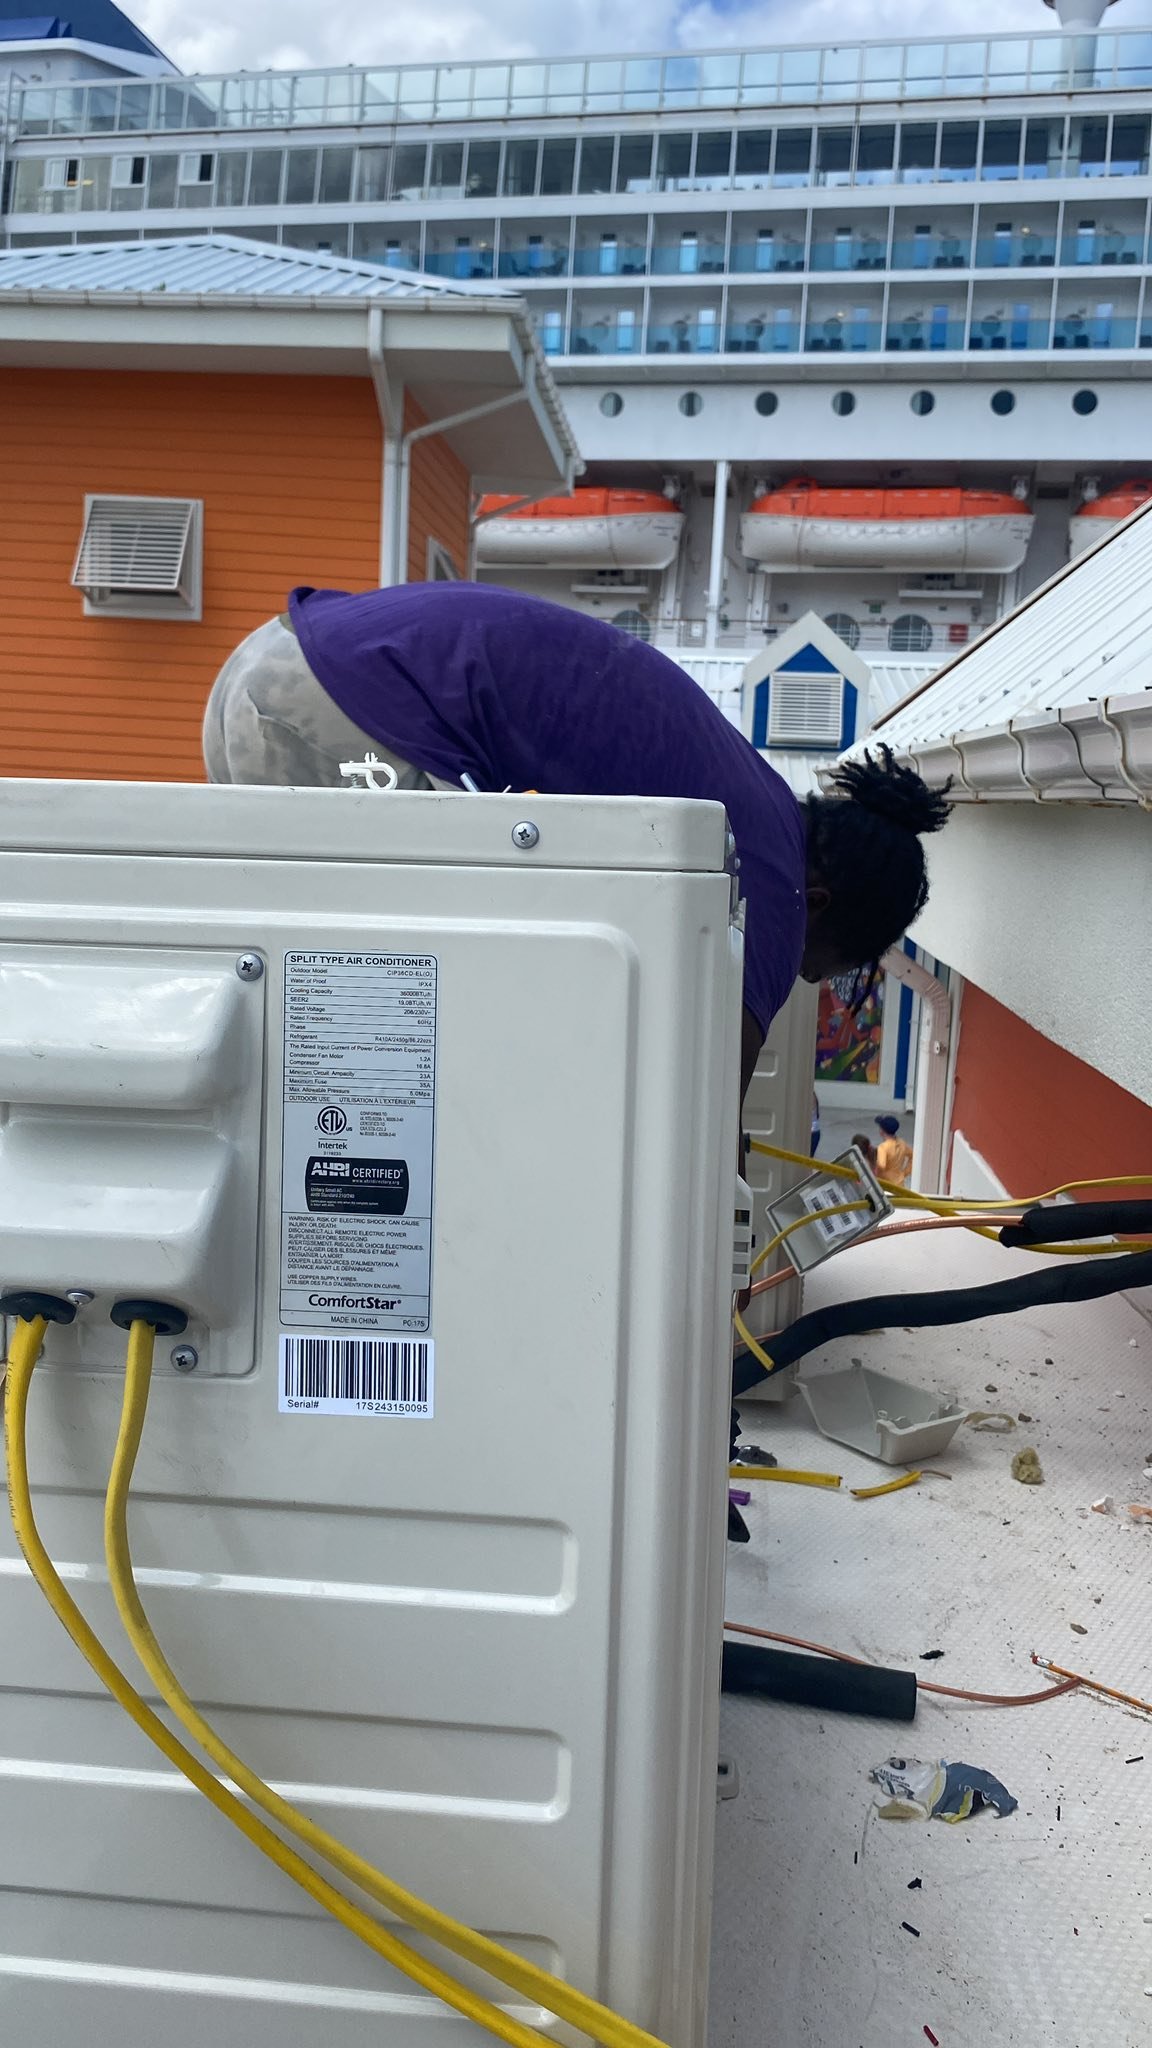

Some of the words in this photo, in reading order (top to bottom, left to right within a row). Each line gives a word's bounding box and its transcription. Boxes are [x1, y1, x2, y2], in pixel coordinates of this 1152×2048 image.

[290, 955, 318, 964] SPLIT
[320, 956, 345, 965] TYPE
[346, 957, 363, 965] AIR
[365, 957, 432, 967] CONDITIONER
[318, 1141, 348, 1150] Intertek
[310, 1162, 350, 1177] AHRI
[352, 1168, 401, 1179] CERTIFIED
[308, 1294, 397, 1310] ComfortStar
[287, 1399, 320, 1409] Serial#
[356, 1402, 428, 1413] 17S243150095
